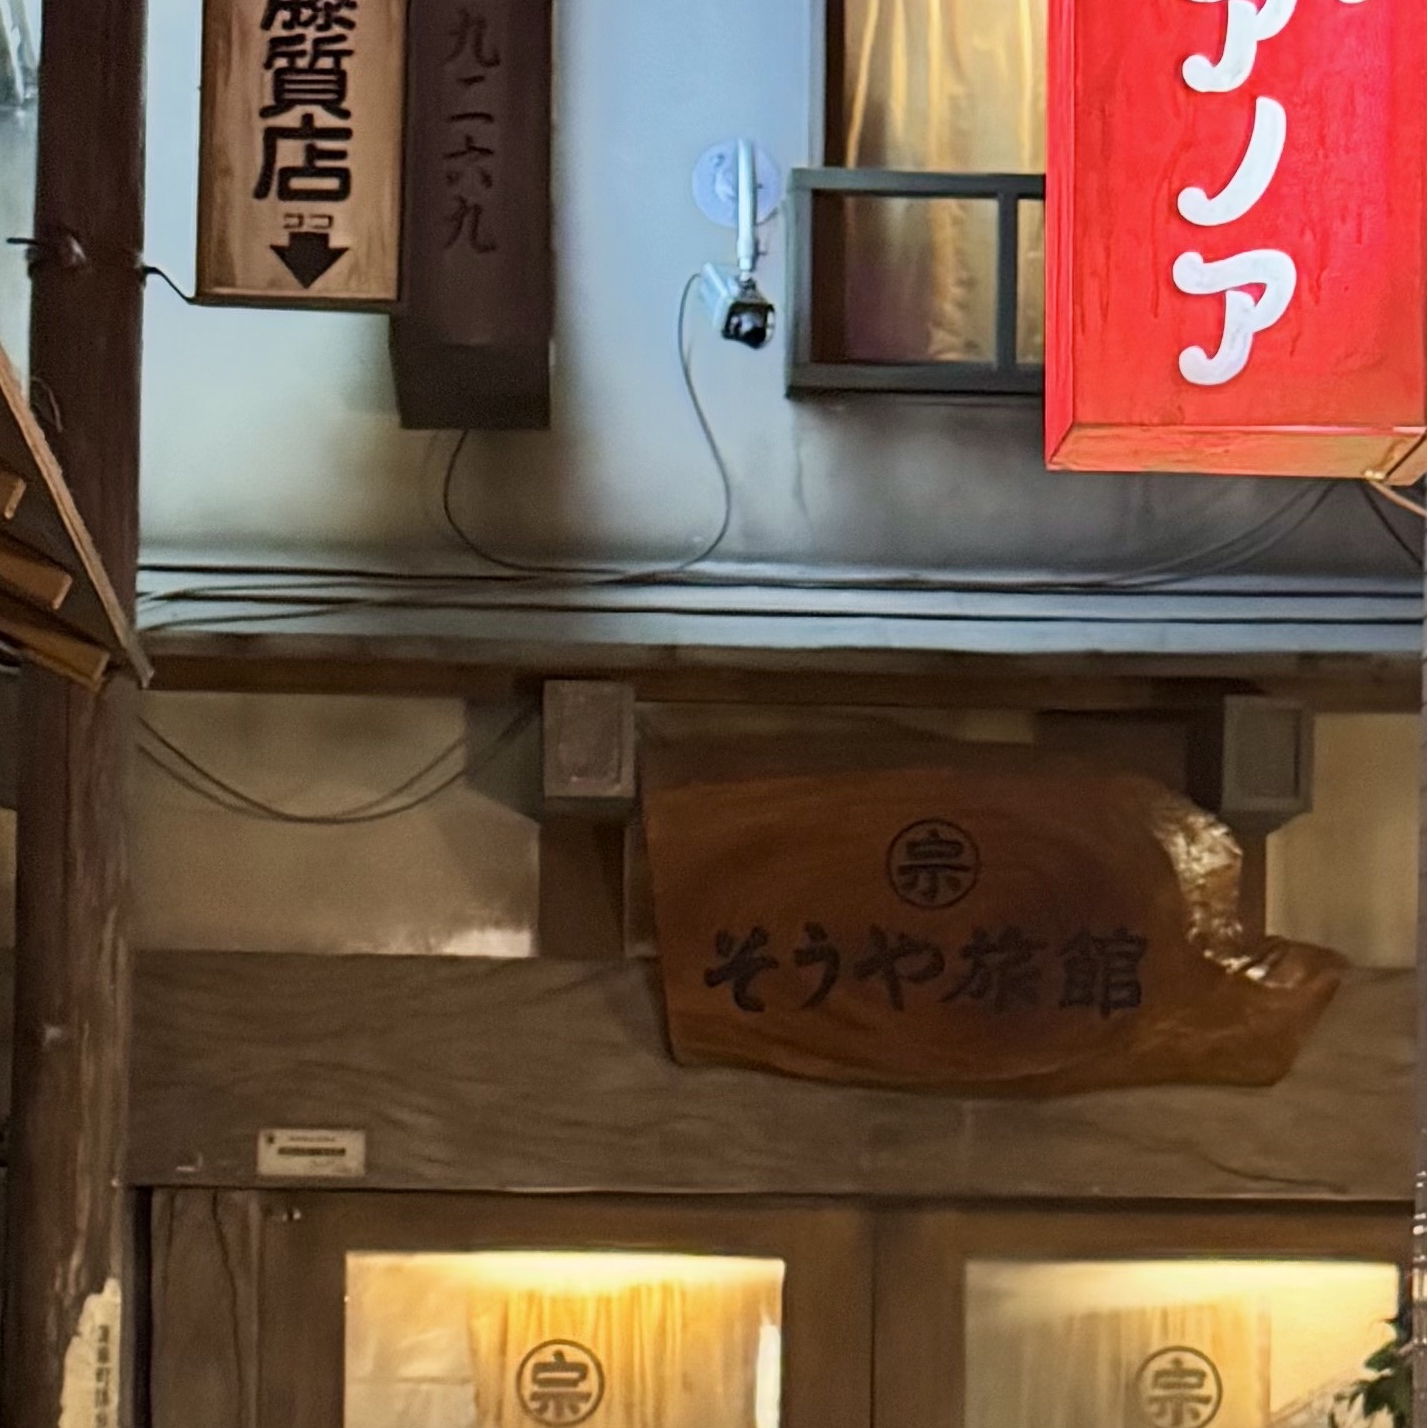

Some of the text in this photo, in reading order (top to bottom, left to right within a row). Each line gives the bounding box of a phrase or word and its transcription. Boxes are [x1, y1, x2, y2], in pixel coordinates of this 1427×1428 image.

[703, 921, 1149, 1020] そうや旅館
